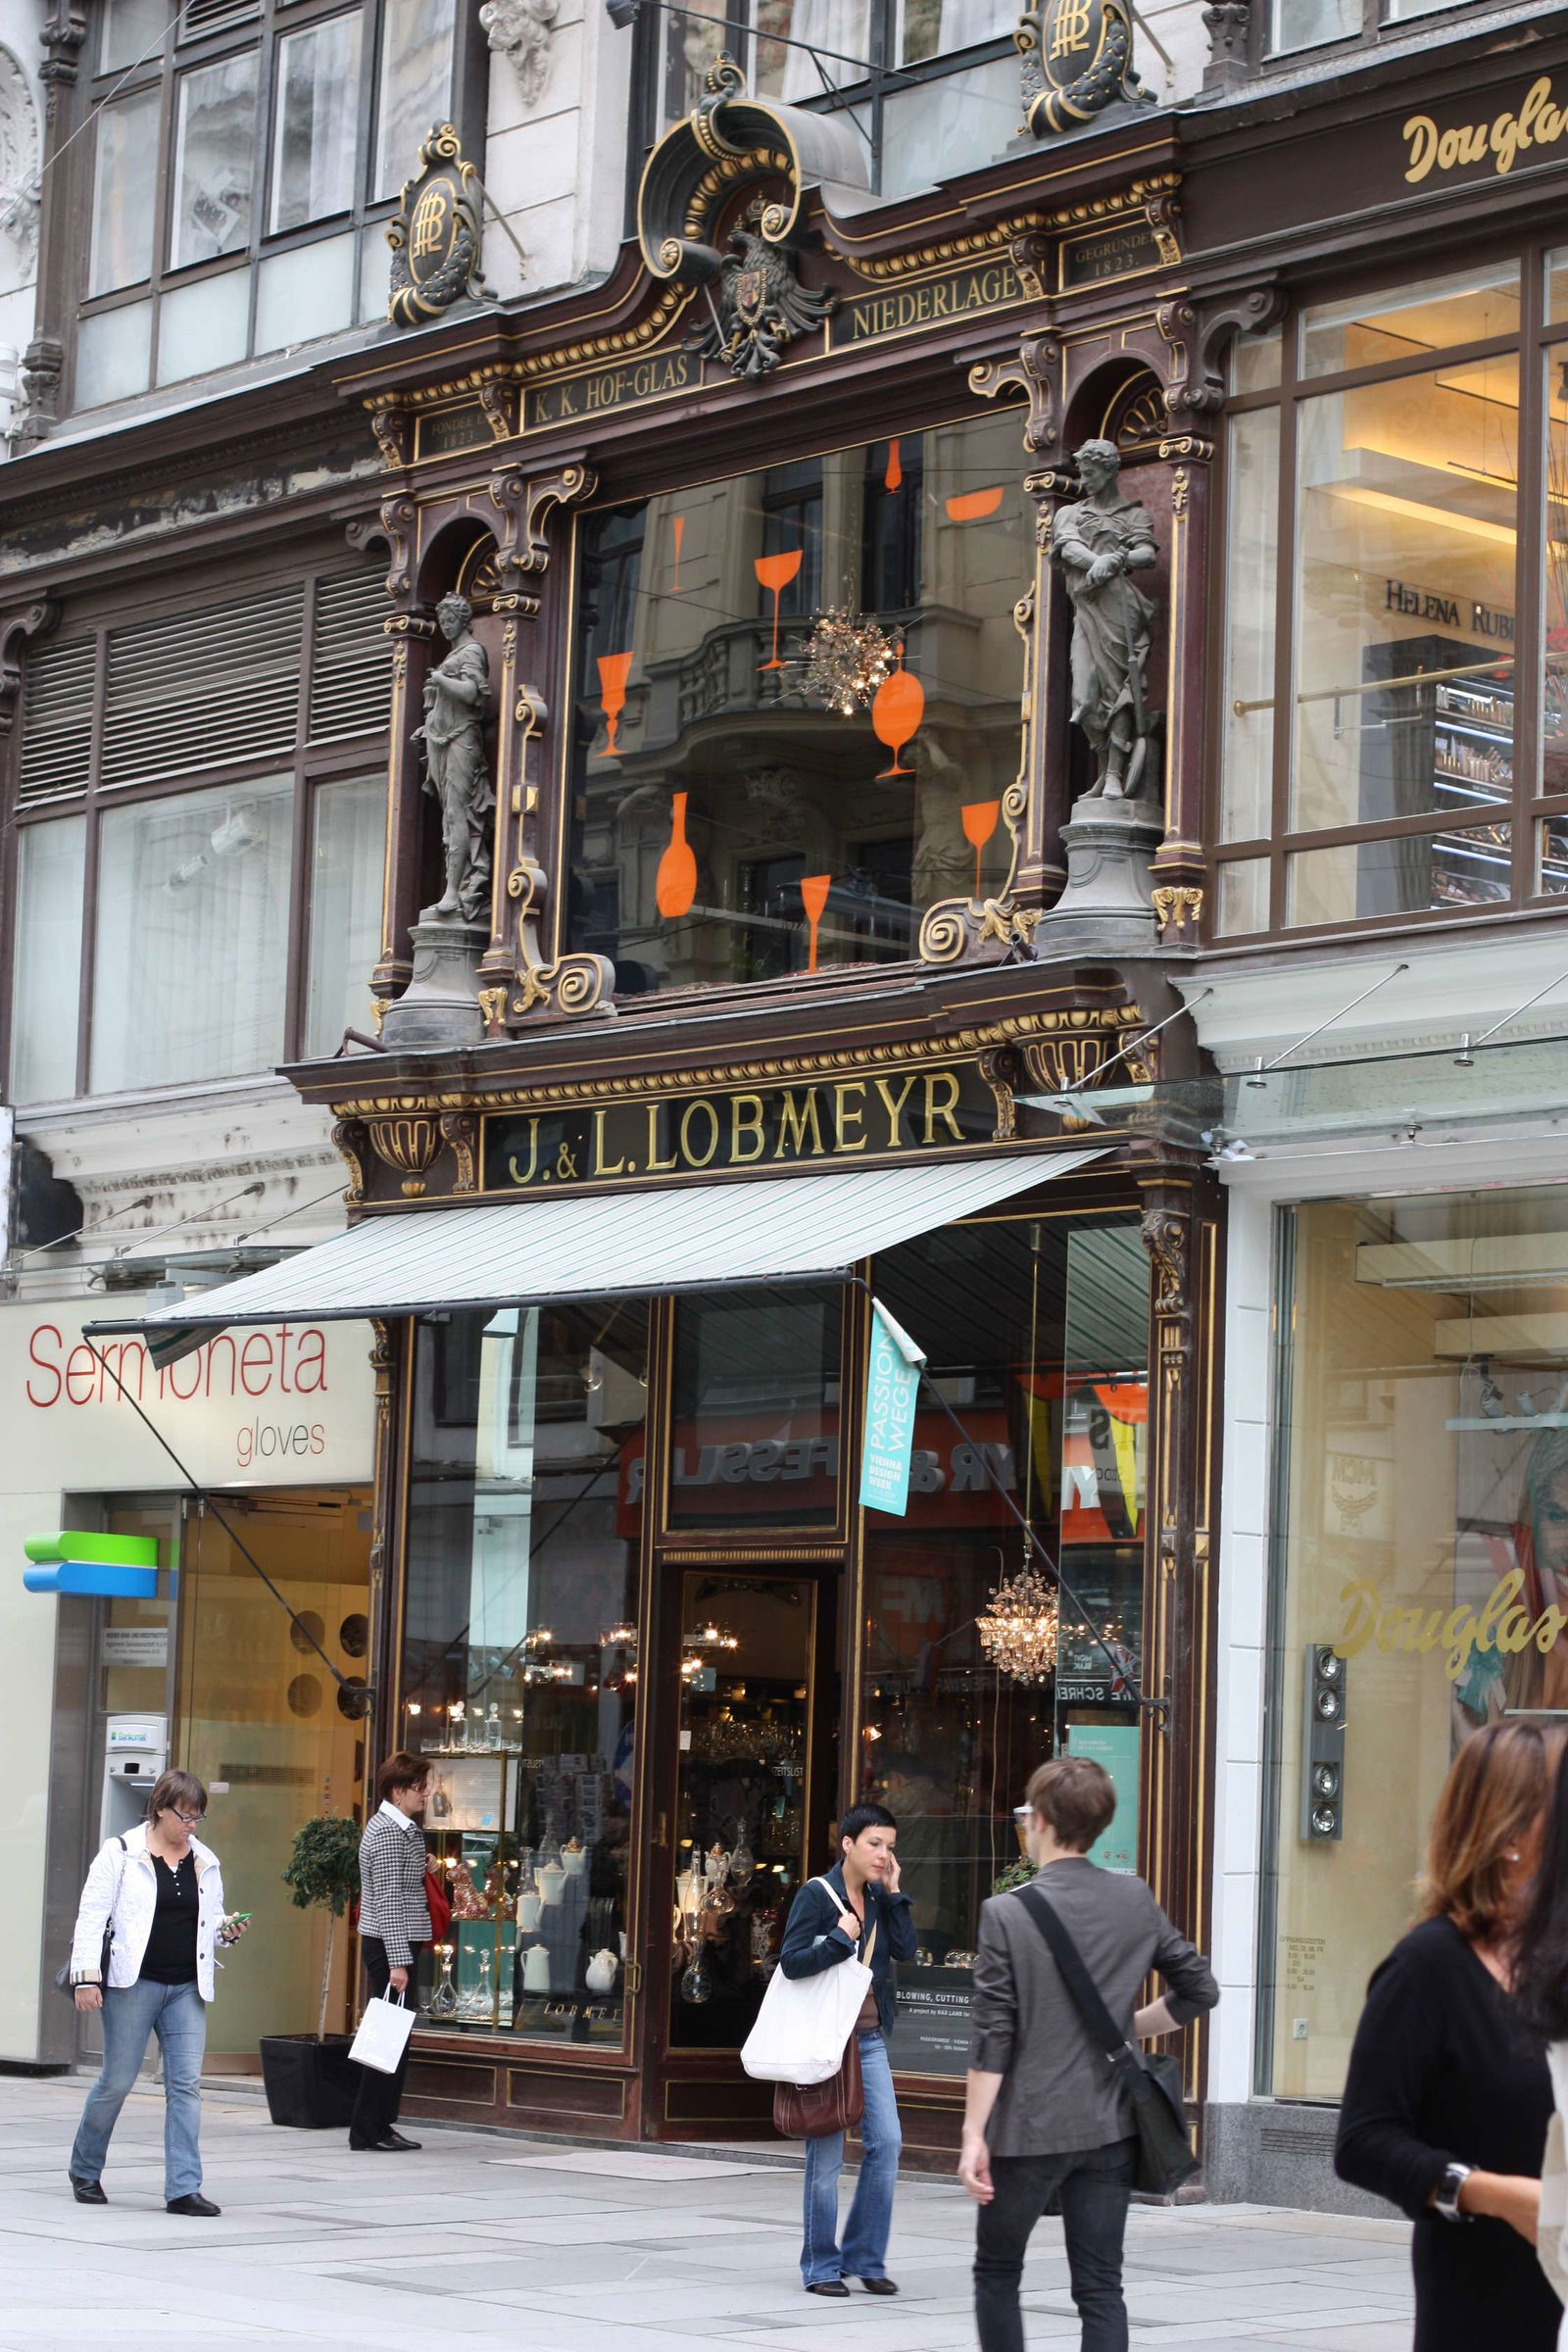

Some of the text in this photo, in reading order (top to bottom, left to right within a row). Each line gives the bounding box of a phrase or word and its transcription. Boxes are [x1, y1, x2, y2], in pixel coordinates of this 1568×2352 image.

[1403, 76, 1568, 183] Dougla
[1095, 253, 1140, 276] 1823.
[852, 266, 1018, 339] NIEDERLAGE
[534, 355, 688, 423] K. K. HOF-GLAS
[1385, 579, 1461, 627] HELENA
[26, 1323, 328, 1407] Sermoneta
[237, 1416, 325, 1467] gloves
[869, 1452, 903, 1472] VIENNA
[869, 1464, 901, 1482] DESIGN
[869, 1475, 893, 1491] WEEK
[1333, 1567, 1568, 1681] Douglas
[896, 1990, 969, 2004] BLOWING, CUTTING
